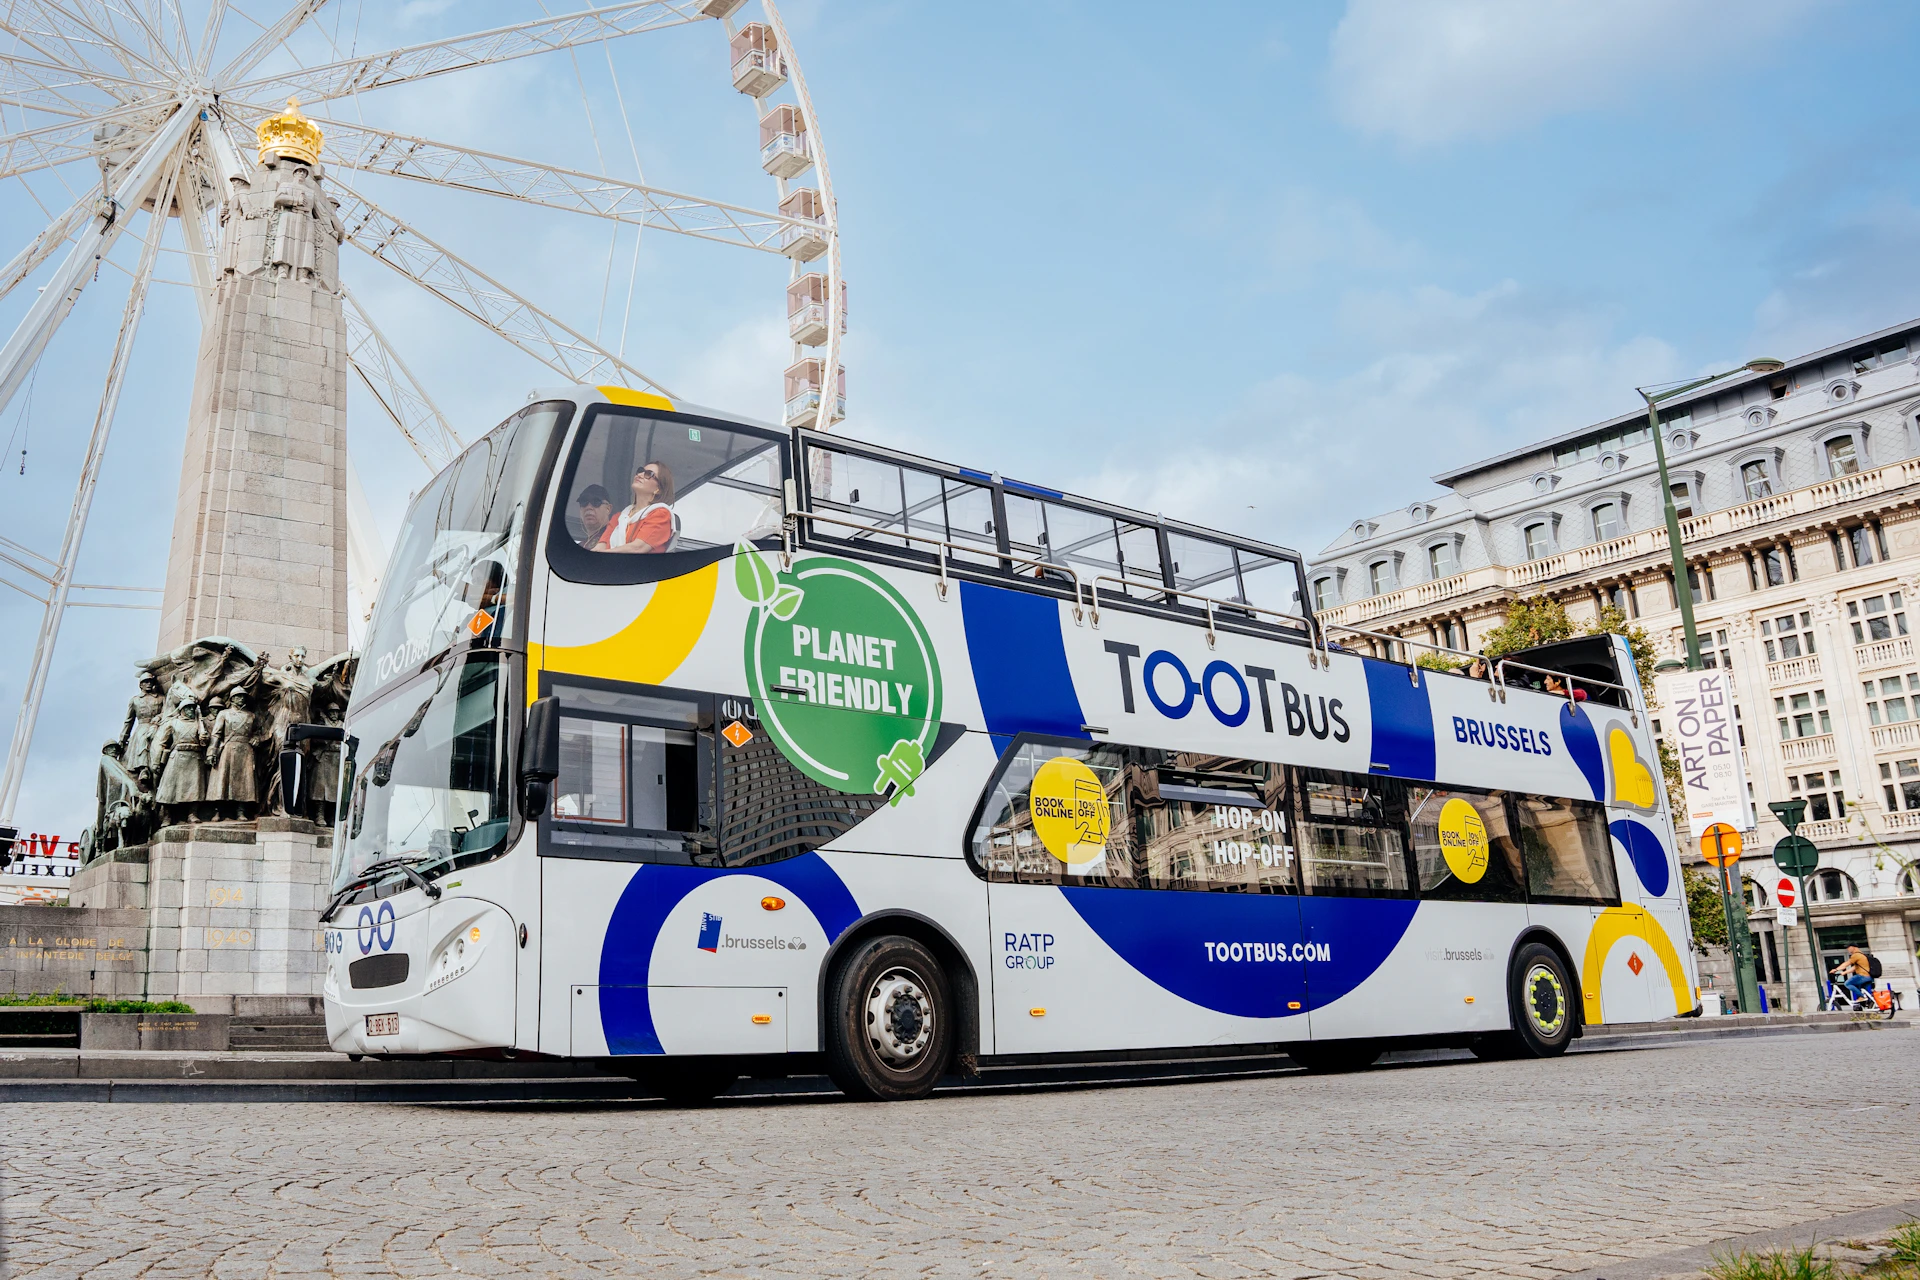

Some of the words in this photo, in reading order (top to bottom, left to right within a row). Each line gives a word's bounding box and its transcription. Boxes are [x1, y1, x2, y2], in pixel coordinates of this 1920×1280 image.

[792, 624, 897, 671] PLANET
[779, 666, 913, 716] FRIENDLY
[1103, 639, 1351, 743] TOOTBUS
[1675, 698, 1700, 738] ON
[1699, 674, 1731, 757] PAPER
[1452, 716, 1552, 756] BRUSSELS
[1680, 742, 1710, 791] ART
[1712, 762, 1731, 771] 05.10
[1713, 770, 1732, 779] 08.10
[1035, 796, 1065, 808] BOOK
[1079, 800, 1096, 811] 10%
[1035, 807, 1074, 819] ONLINE
[1078, 808, 1096, 819] OFF
[1214, 805, 1287, 834] HOP-ON
[1441, 830, 1460, 839] BOOK
[1442, 838, 1467, 848] ONLINE
[1468, 831, 1479, 840] 10%
[1468, 838, 1480, 847] OFF
[1214, 840, 1294, 868] HOP-OFF
[209, 887, 244, 907] 1914
[9, 937, 17, 945] A
[28, 936, 44, 946] LA
[108, 938, 125, 948] DE
[206, 929, 252, 949] 1940
[721, 934, 786, 950] .brussels
[1004, 932, 1055, 952] RATP
[1204, 941, 1331, 962] TOOTBUS.COM
[1005, 955, 1055, 970] GROUP
